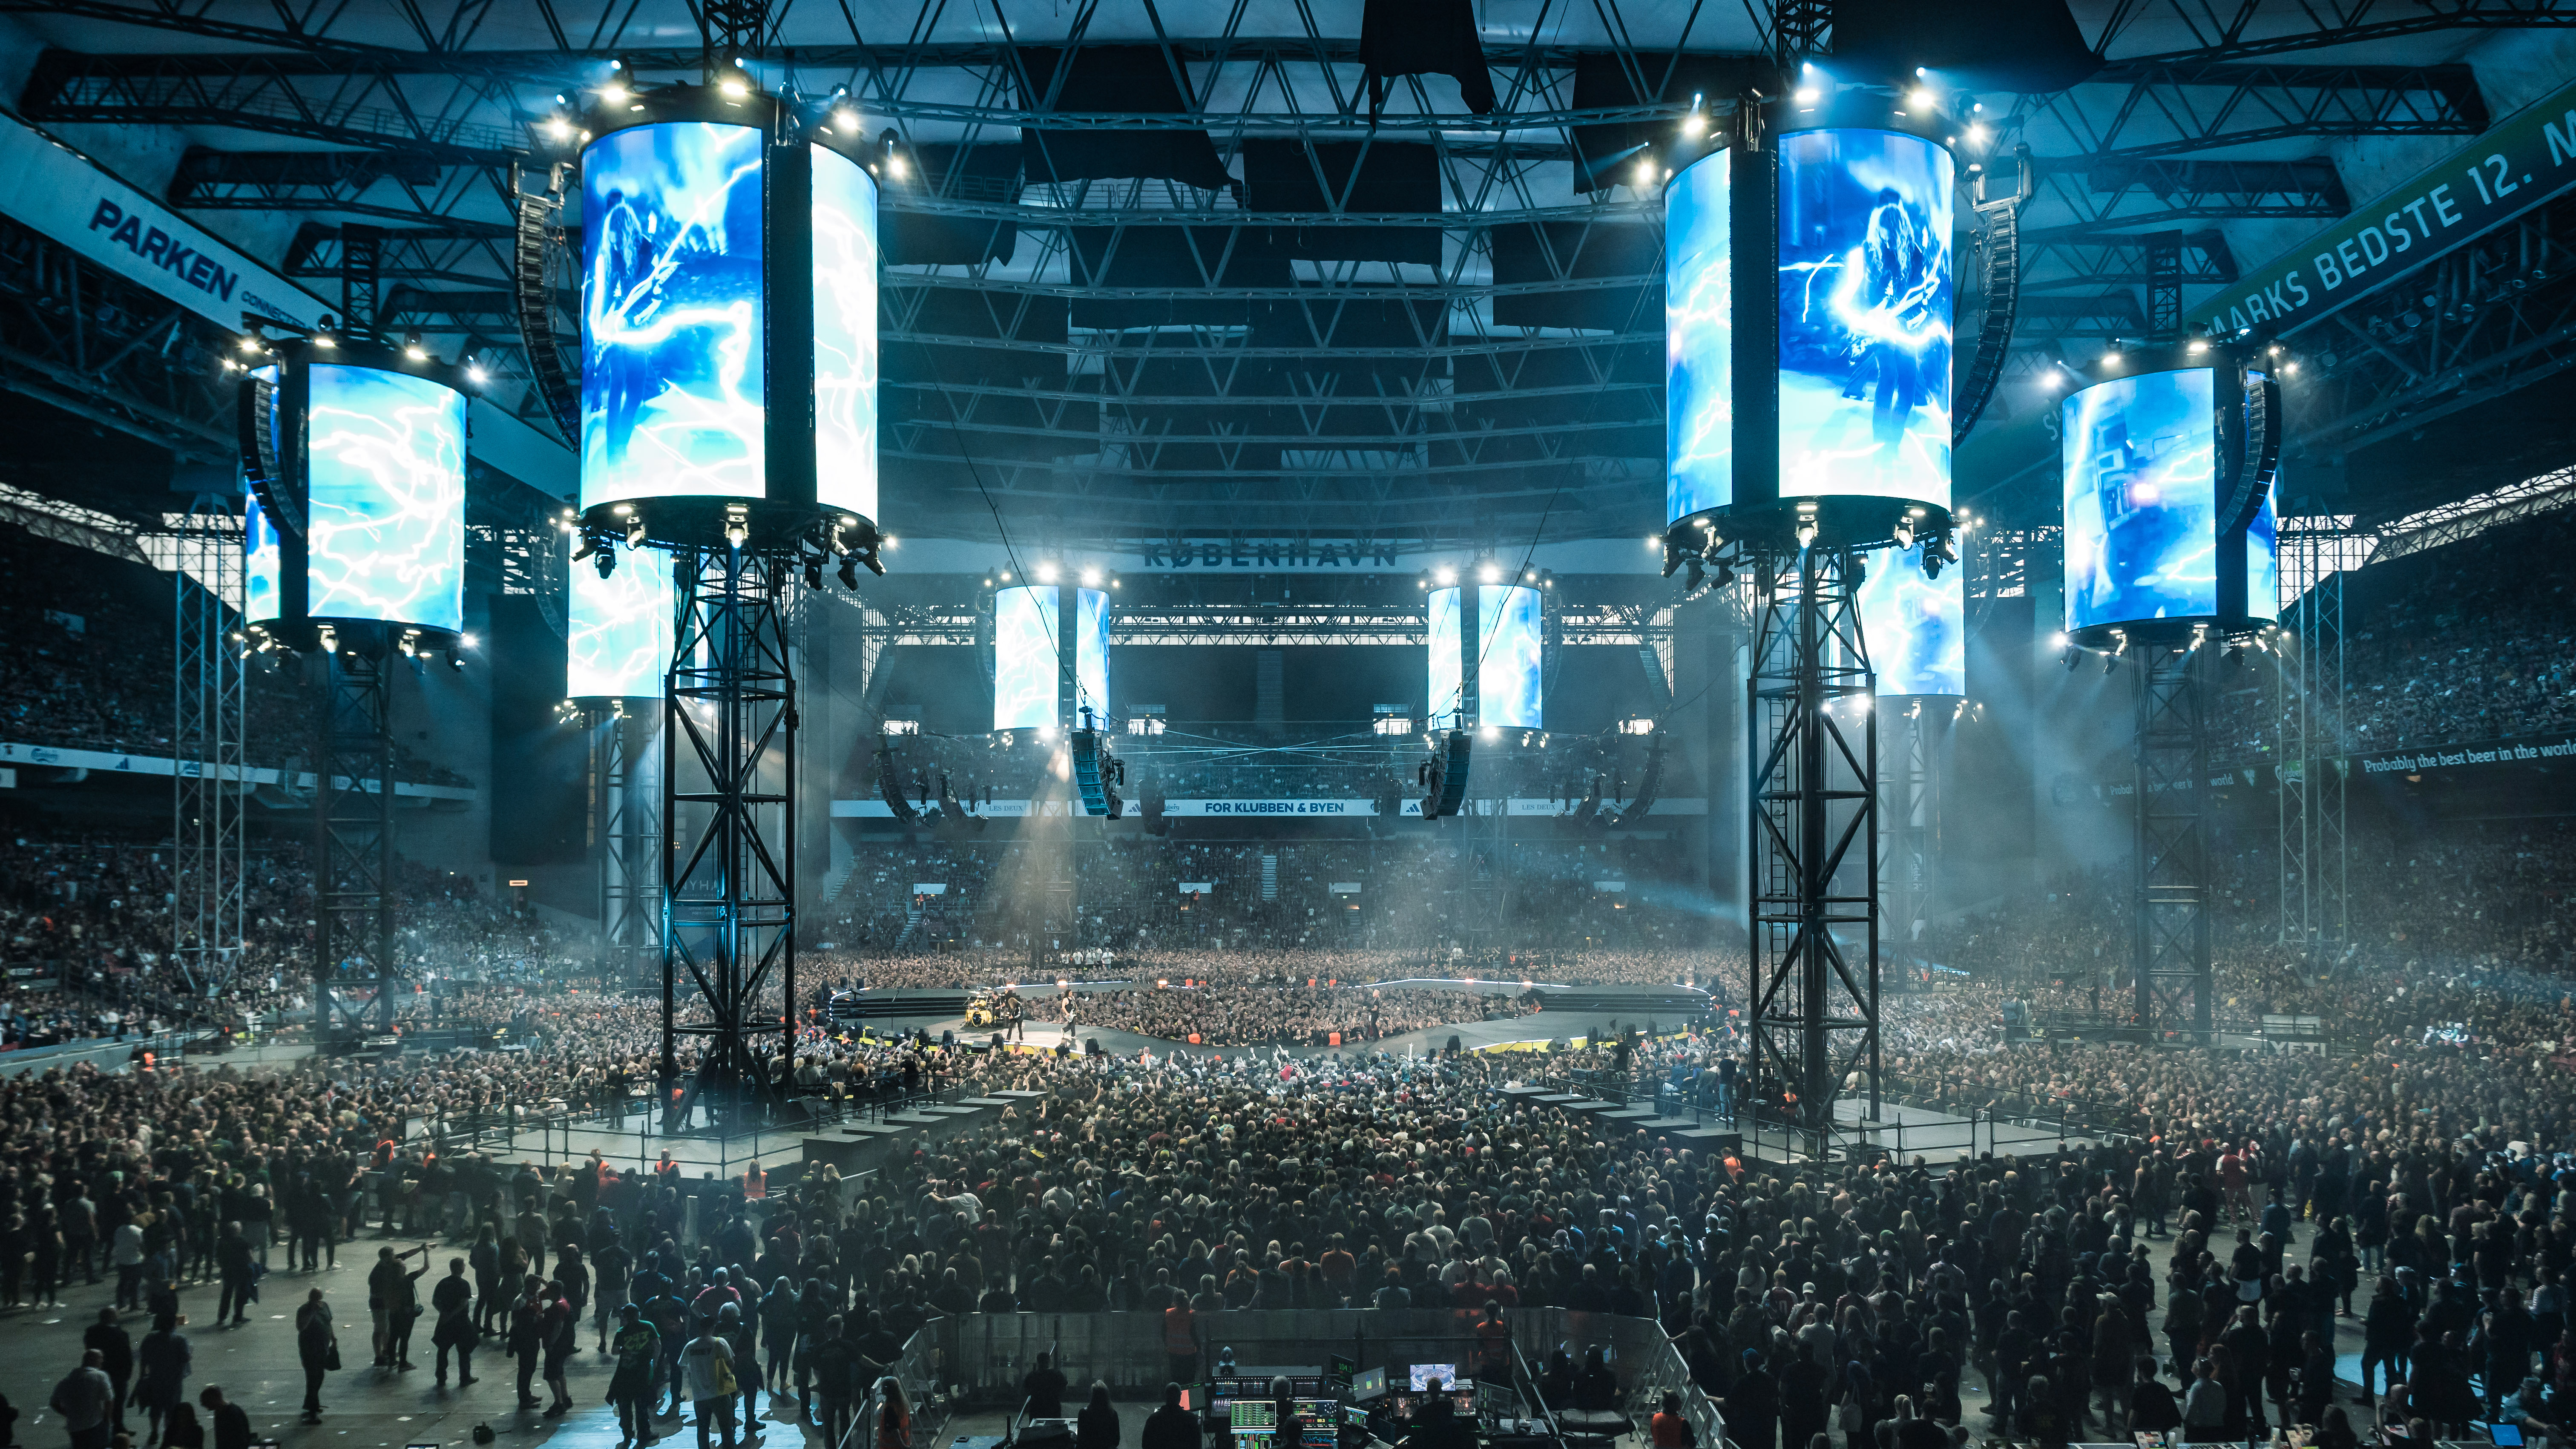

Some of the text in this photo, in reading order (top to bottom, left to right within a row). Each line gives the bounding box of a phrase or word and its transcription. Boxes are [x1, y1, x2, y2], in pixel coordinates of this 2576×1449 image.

[2314, 183, 2462, 291] BEDSTE
[2467, 154, 2533, 205] 12.
[89, 198, 239, 302] PARKEN
[1144, 542, 1396, 569] KØBENHAVN
[2363, 756, 2417, 772] Probably
[2418, 753, 2437, 768] the
[2438, 752, 2466, 766] best
[2466, 749, 2496, 763] beer
[2498, 747, 2513, 760] in
[2514, 744, 2538, 759] the
[2210, 773, 2234, 786] world
[1205, 803, 1344, 813] FOR KLUBBEN & BYEN
[1339, 1363, 1352, 1373] 104.3
